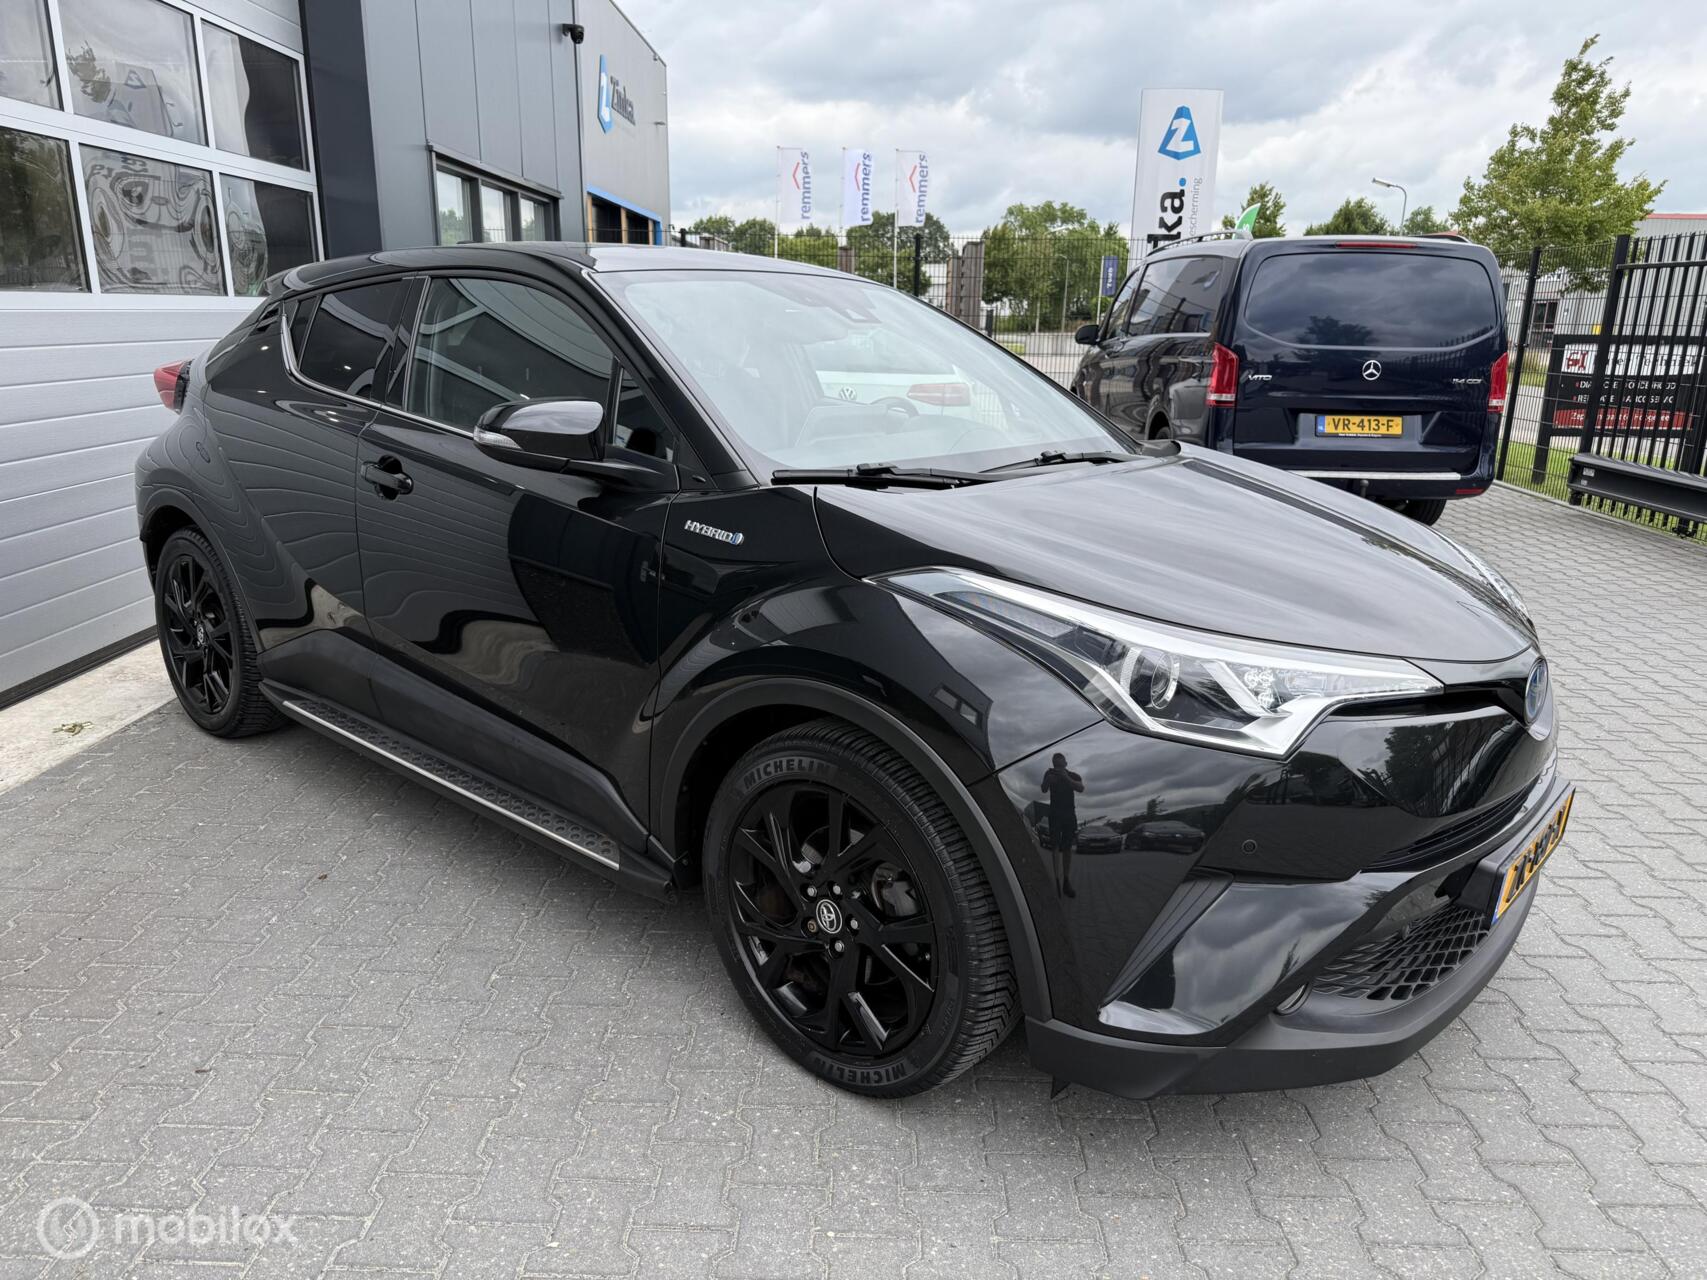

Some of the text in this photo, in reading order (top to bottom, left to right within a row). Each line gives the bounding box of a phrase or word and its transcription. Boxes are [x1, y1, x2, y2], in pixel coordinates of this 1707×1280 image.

[800, 151, 811, 220] remmers
[860, 153, 872, 222] remmers
[915, 154, 928, 223] remmers
[1146, 177, 1187, 249] ka.
[1188, 177, 1203, 236] escherming
[1332, 417, 1394, 432] VR-413-F
[684, 519, 733, 543] HYBRID
[743, 758, 831, 790] MICHELIN
